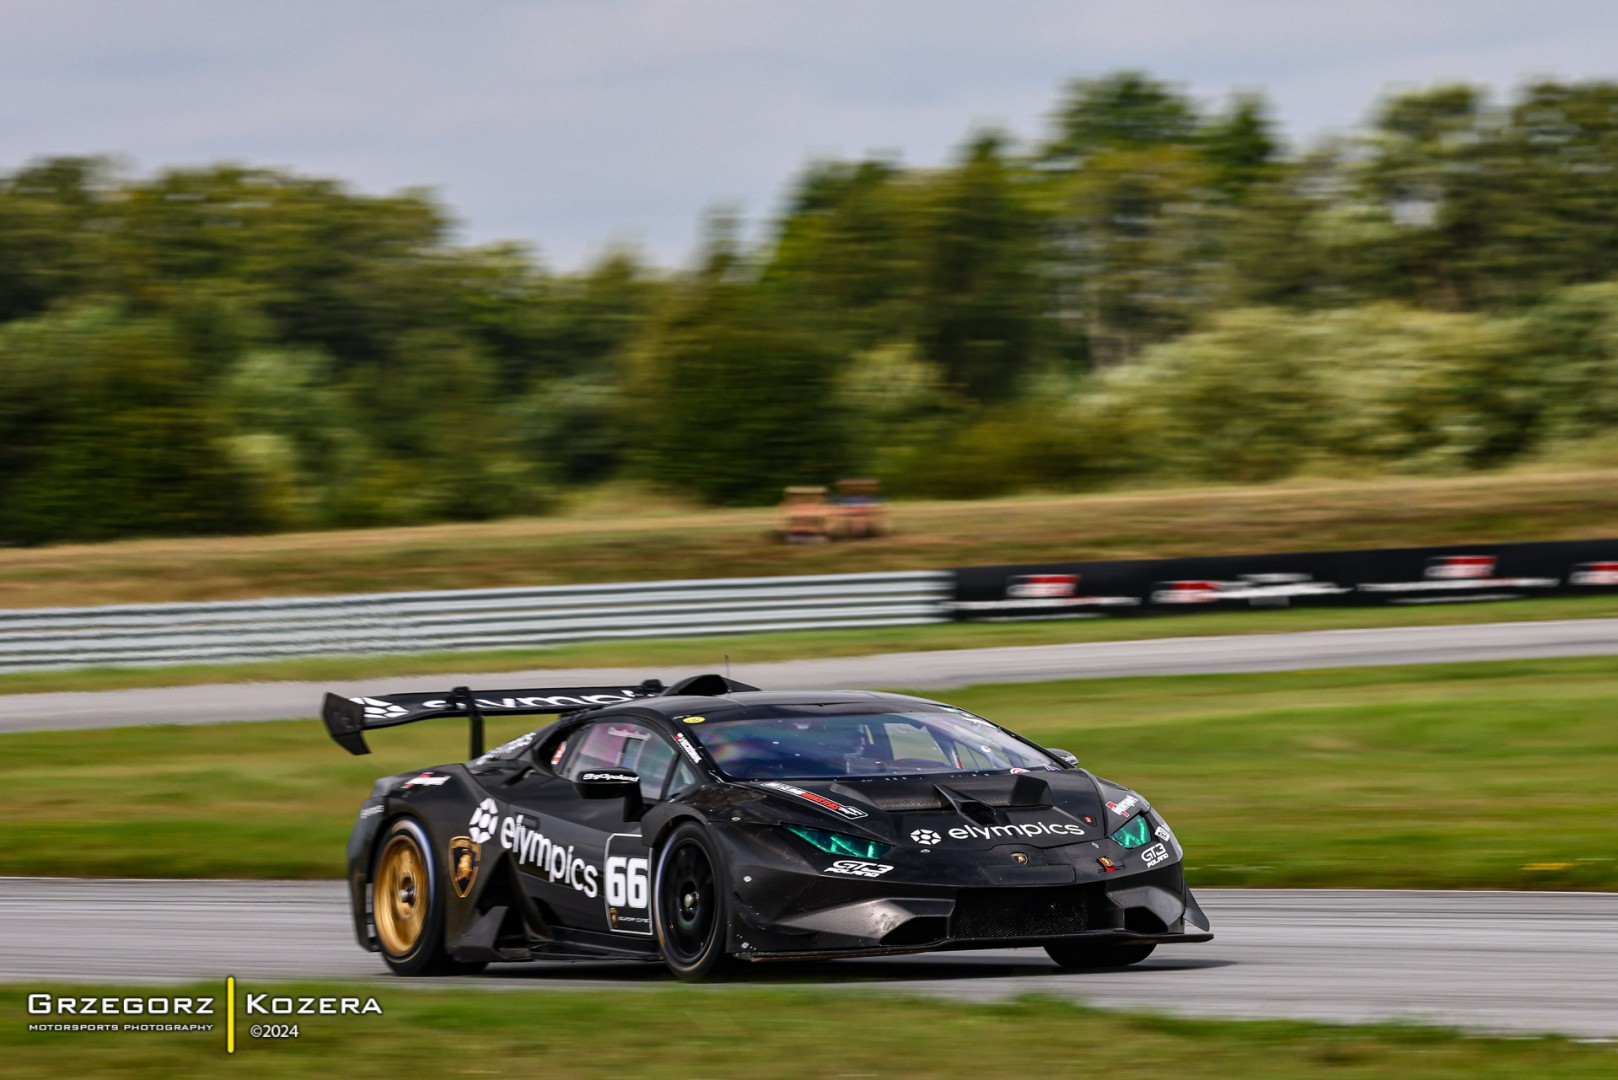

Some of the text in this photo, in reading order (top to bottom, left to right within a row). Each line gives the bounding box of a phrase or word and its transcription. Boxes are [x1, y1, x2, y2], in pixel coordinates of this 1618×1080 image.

[948, 821, 1085, 840] elympics
[500, 814, 598, 898] elympics
[1141, 842, 1166, 862] GT3
[833, 860, 894, 874] GT3
[606, 856, 648, 909] 66
